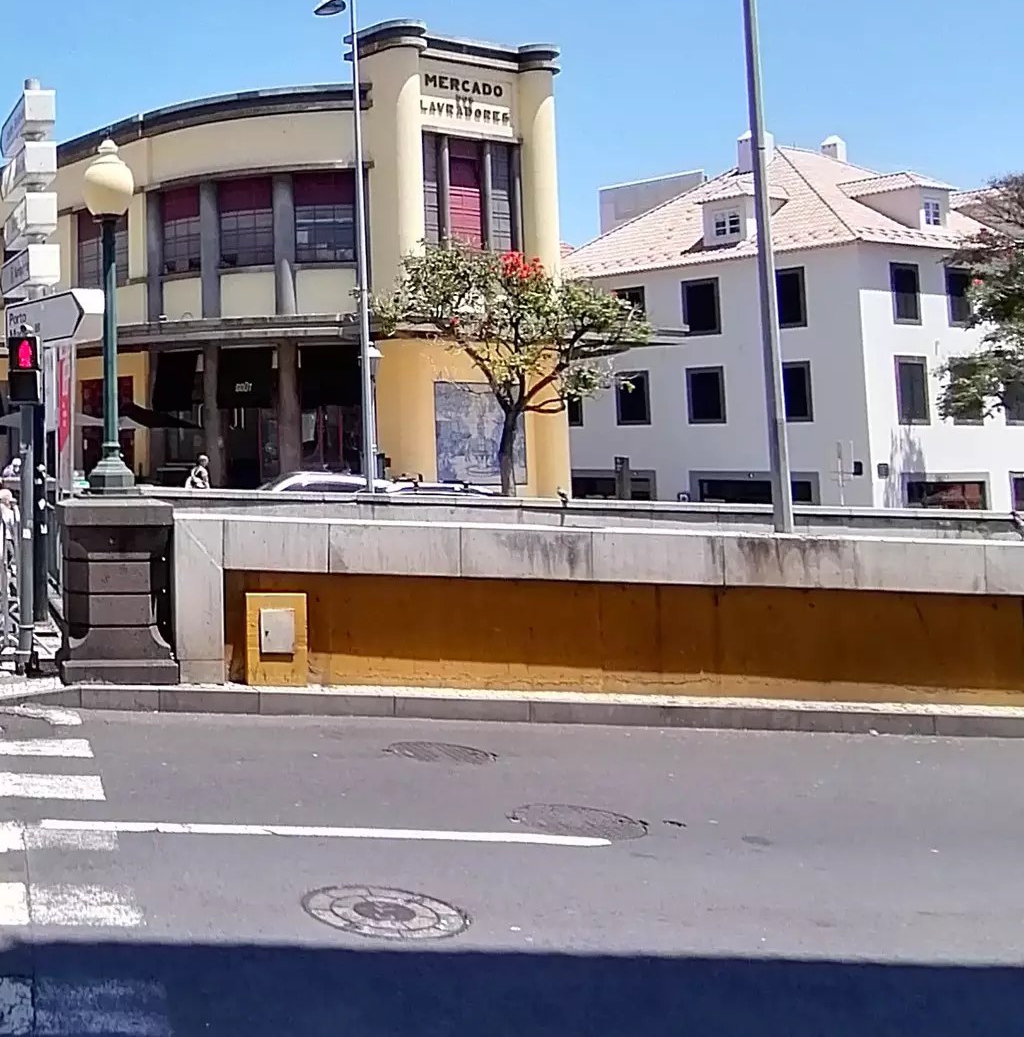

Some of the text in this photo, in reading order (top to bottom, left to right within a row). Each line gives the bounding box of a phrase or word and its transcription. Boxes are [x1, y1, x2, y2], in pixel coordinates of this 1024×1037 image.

[424, 73, 503, 98] MERCADO
[419, 99, 510, 123] LAVRADORES
[9, 313, 27, 326] Porto
